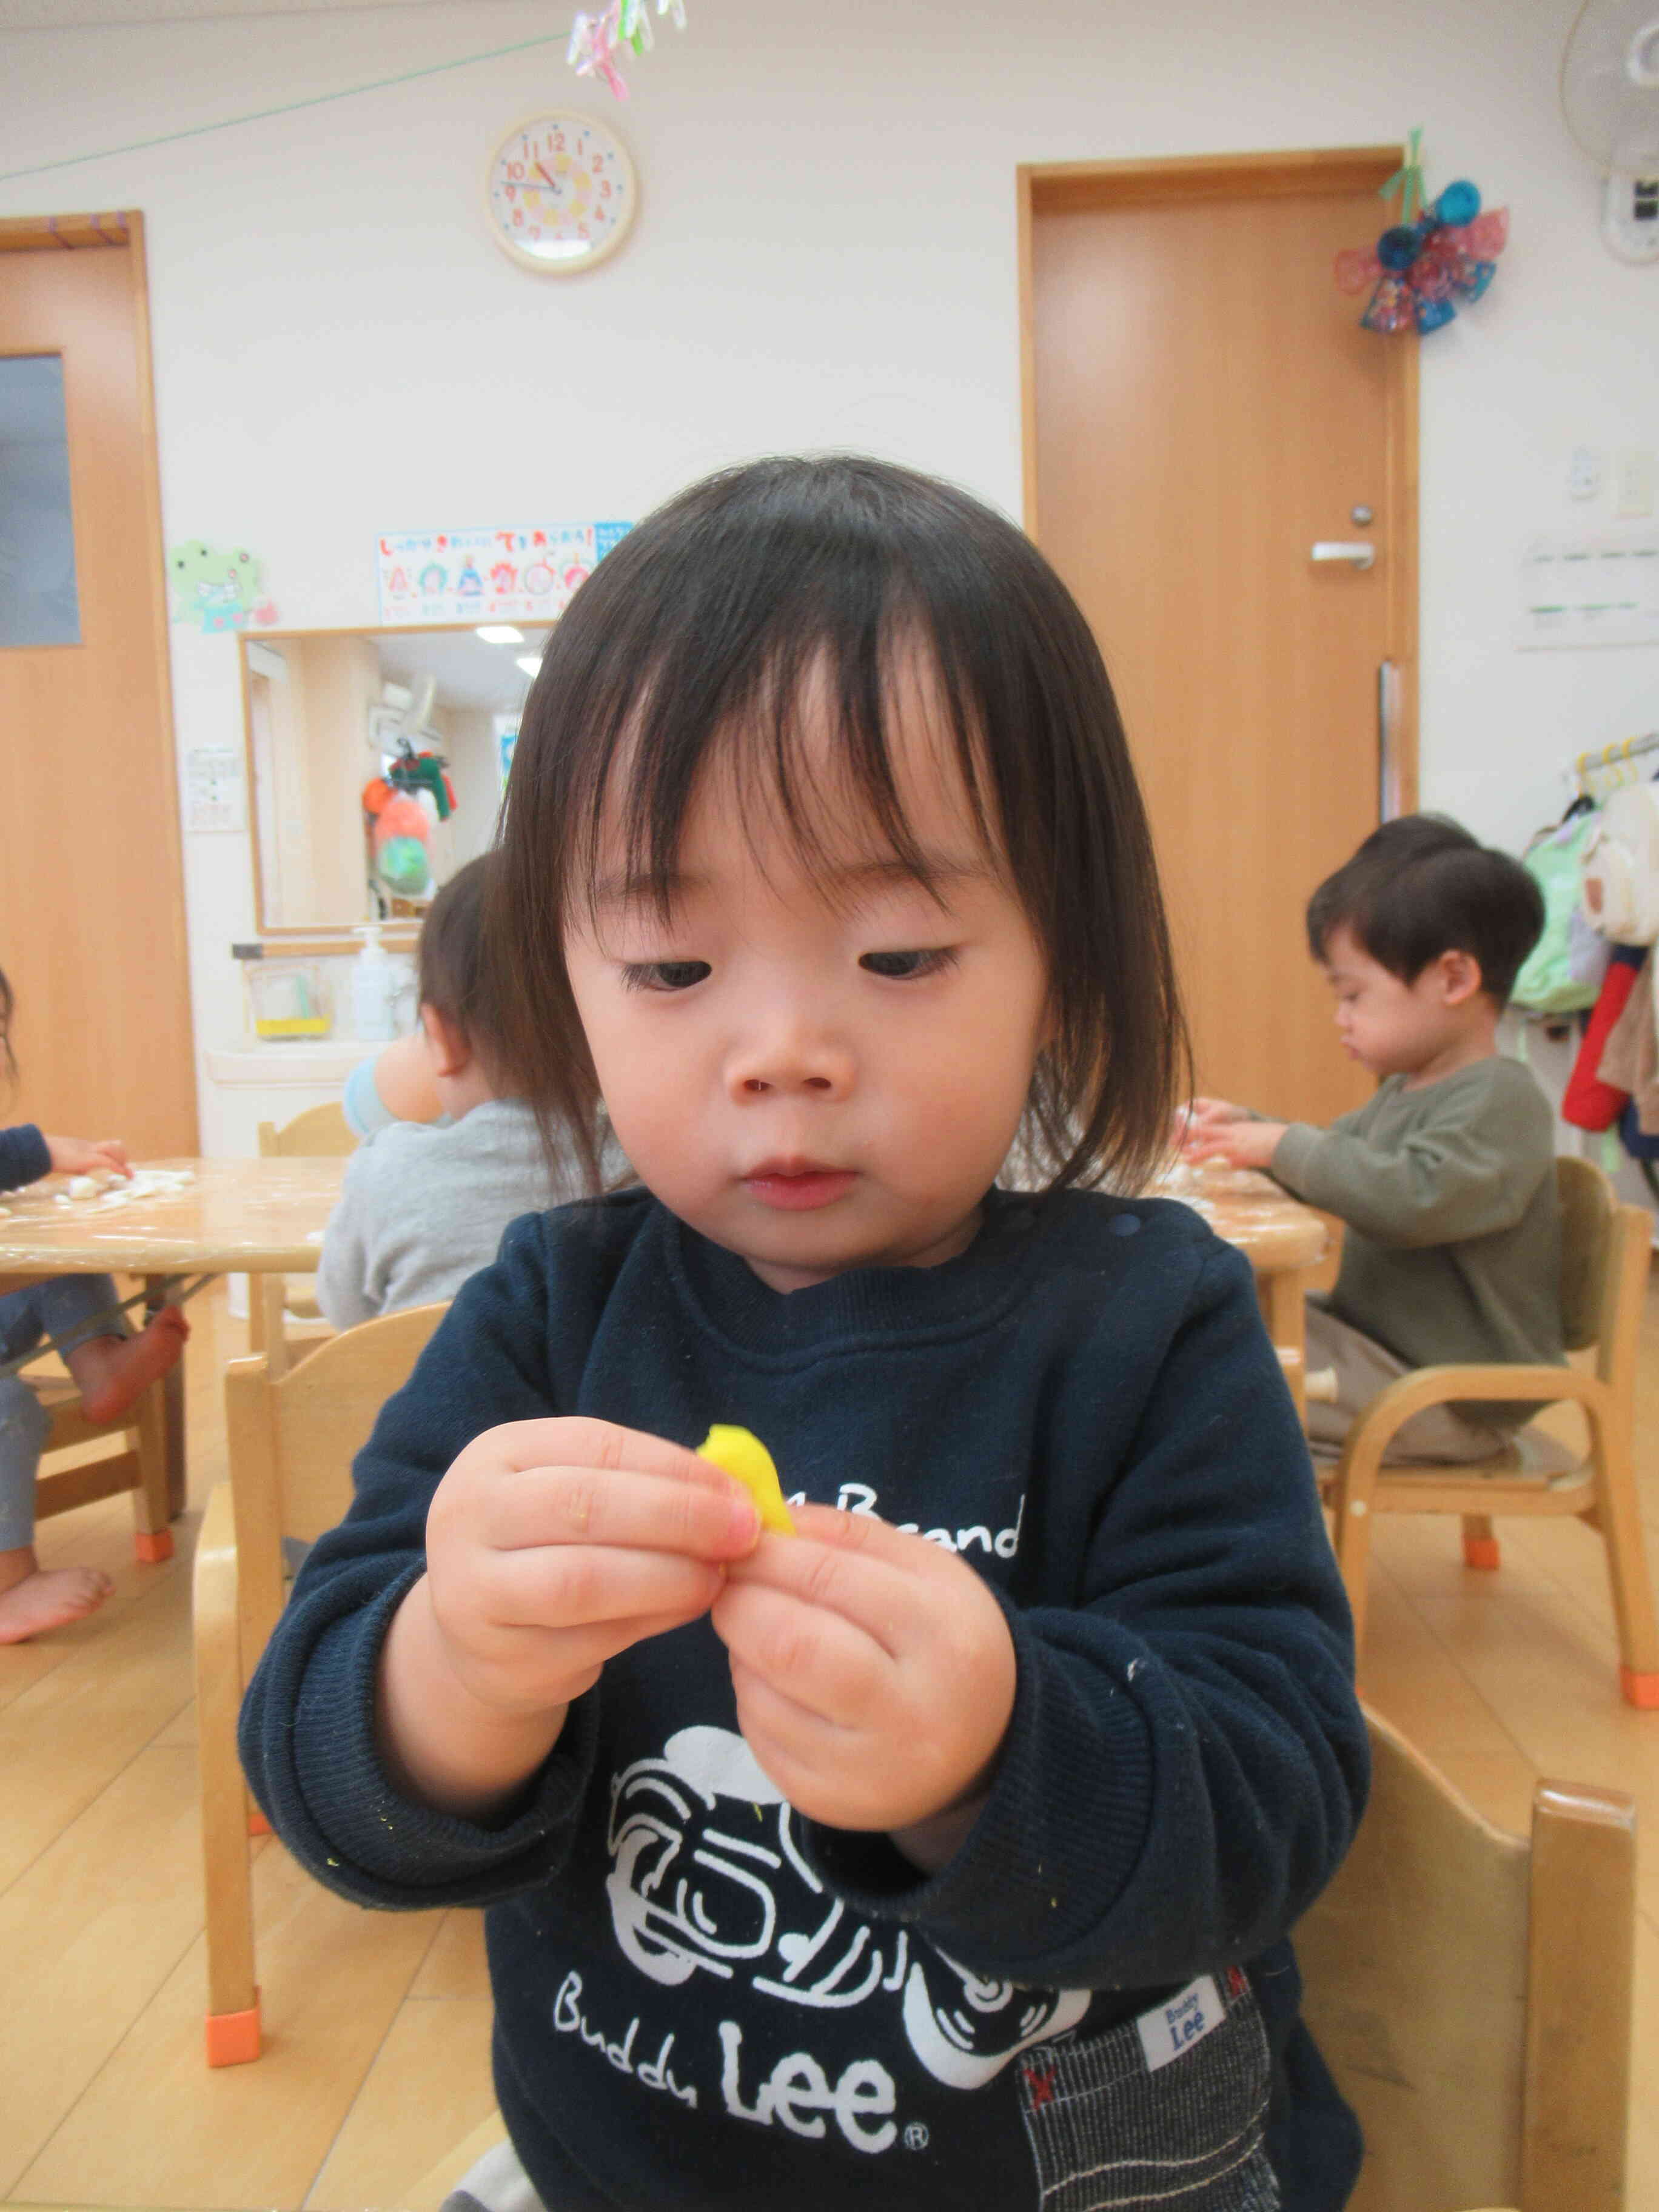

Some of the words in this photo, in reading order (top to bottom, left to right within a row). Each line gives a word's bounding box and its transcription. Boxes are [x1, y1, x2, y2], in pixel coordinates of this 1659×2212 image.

[548, 132, 565, 152] 12
[506, 161, 525, 181] 10
[592, 153, 604, 174] 2
[600, 179, 612, 198] 3
[837, 1483, 1025, 1559] Band
[1171, 2010, 1205, 2051] Lee
[553, 1971, 697, 2109] Buddy
[719, 2020, 898, 2154] Lee
